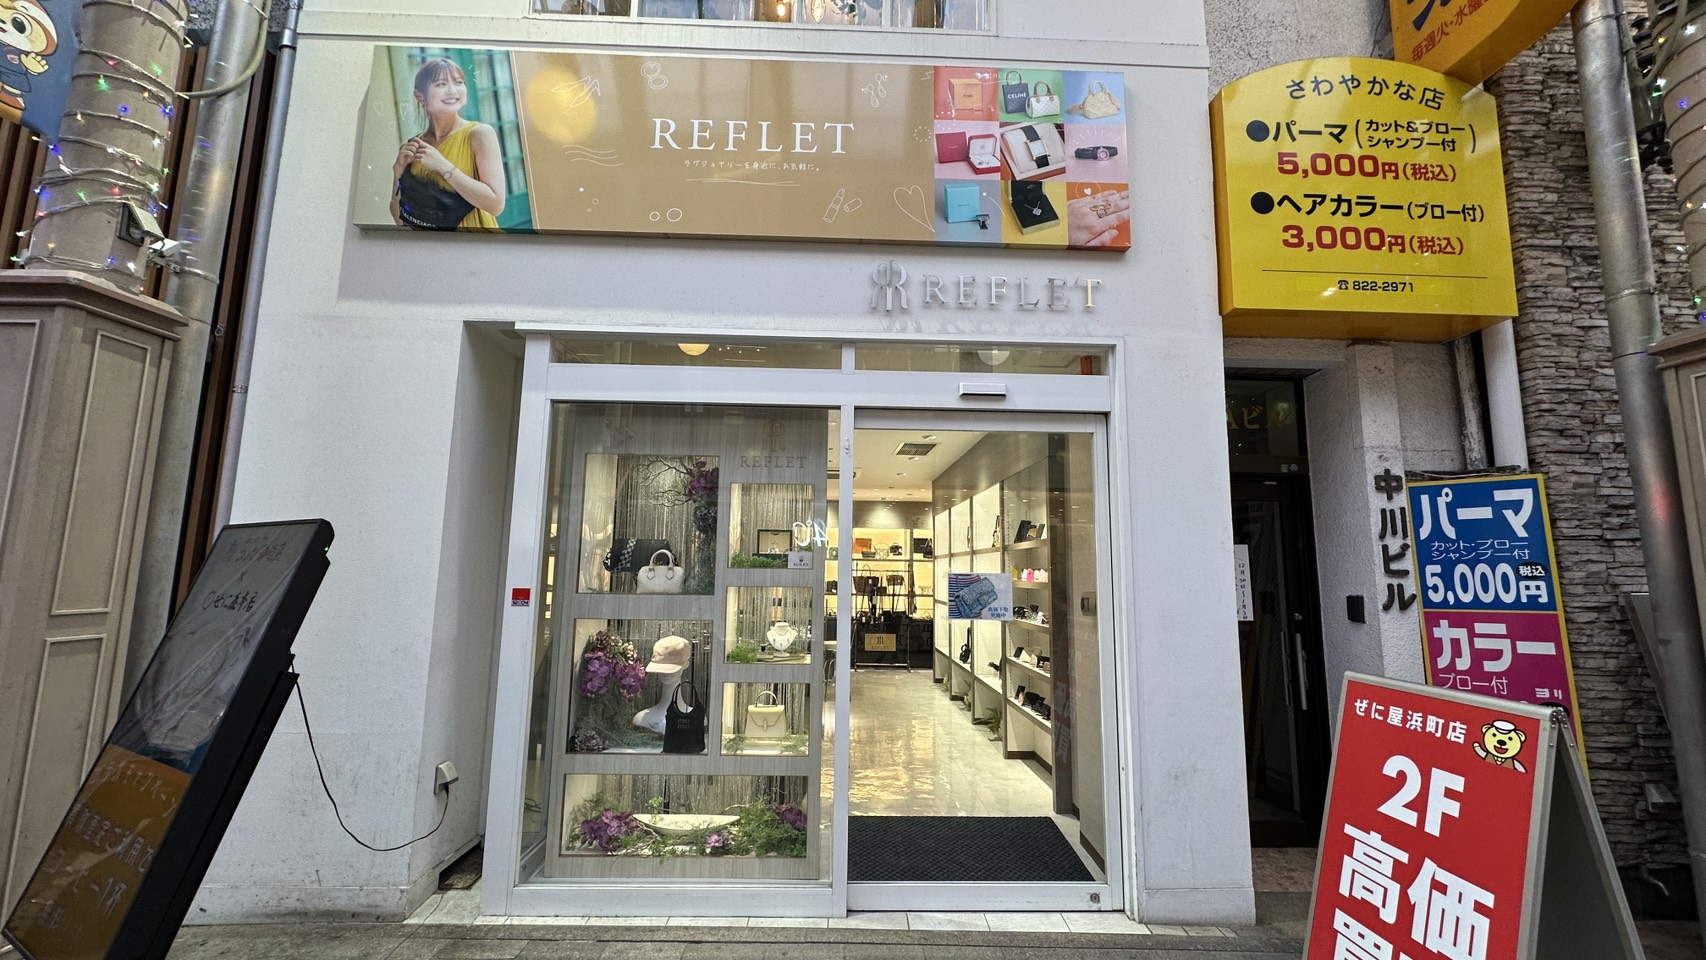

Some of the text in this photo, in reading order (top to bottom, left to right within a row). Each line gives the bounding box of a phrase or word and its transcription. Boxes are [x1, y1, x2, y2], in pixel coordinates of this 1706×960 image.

[1412, 0, 1488, 61] 毎週火・水曜
[1007, 92, 1027, 100] CELINE
[1286, 74, 1446, 111] さわやかな店
[650, 118, 855, 154] REFLET
[1272, 119, 1348, 145] パーマ
[1365, 119, 1465, 134] カット&ブロー
[1367, 135, 1457, 152] シャンプー付
[922, 274, 1103, 309] REFLET
[1352, 281, 1415, 293] 822-2971
[739, 455, 807, 469] REFLET
[1419, 487, 1534, 541] パーマ
[1374, 468, 1417, 612] 中川ビル
[1431, 548, 1531, 561] シャンプー付
[1425, 562, 1549, 606] 5,000円
[1518, 565, 1546, 577] 税込
[1433, 619, 1557, 673] カラー
[1439, 672, 1509, 695] ブロー付
[1535, 687, 1563, 700] ヨリ
[1354, 698, 1468, 744] ぜに屋浜町店
[1376, 755, 1466, 838] 2F
[1338, 823, 1495, 960] 高価
